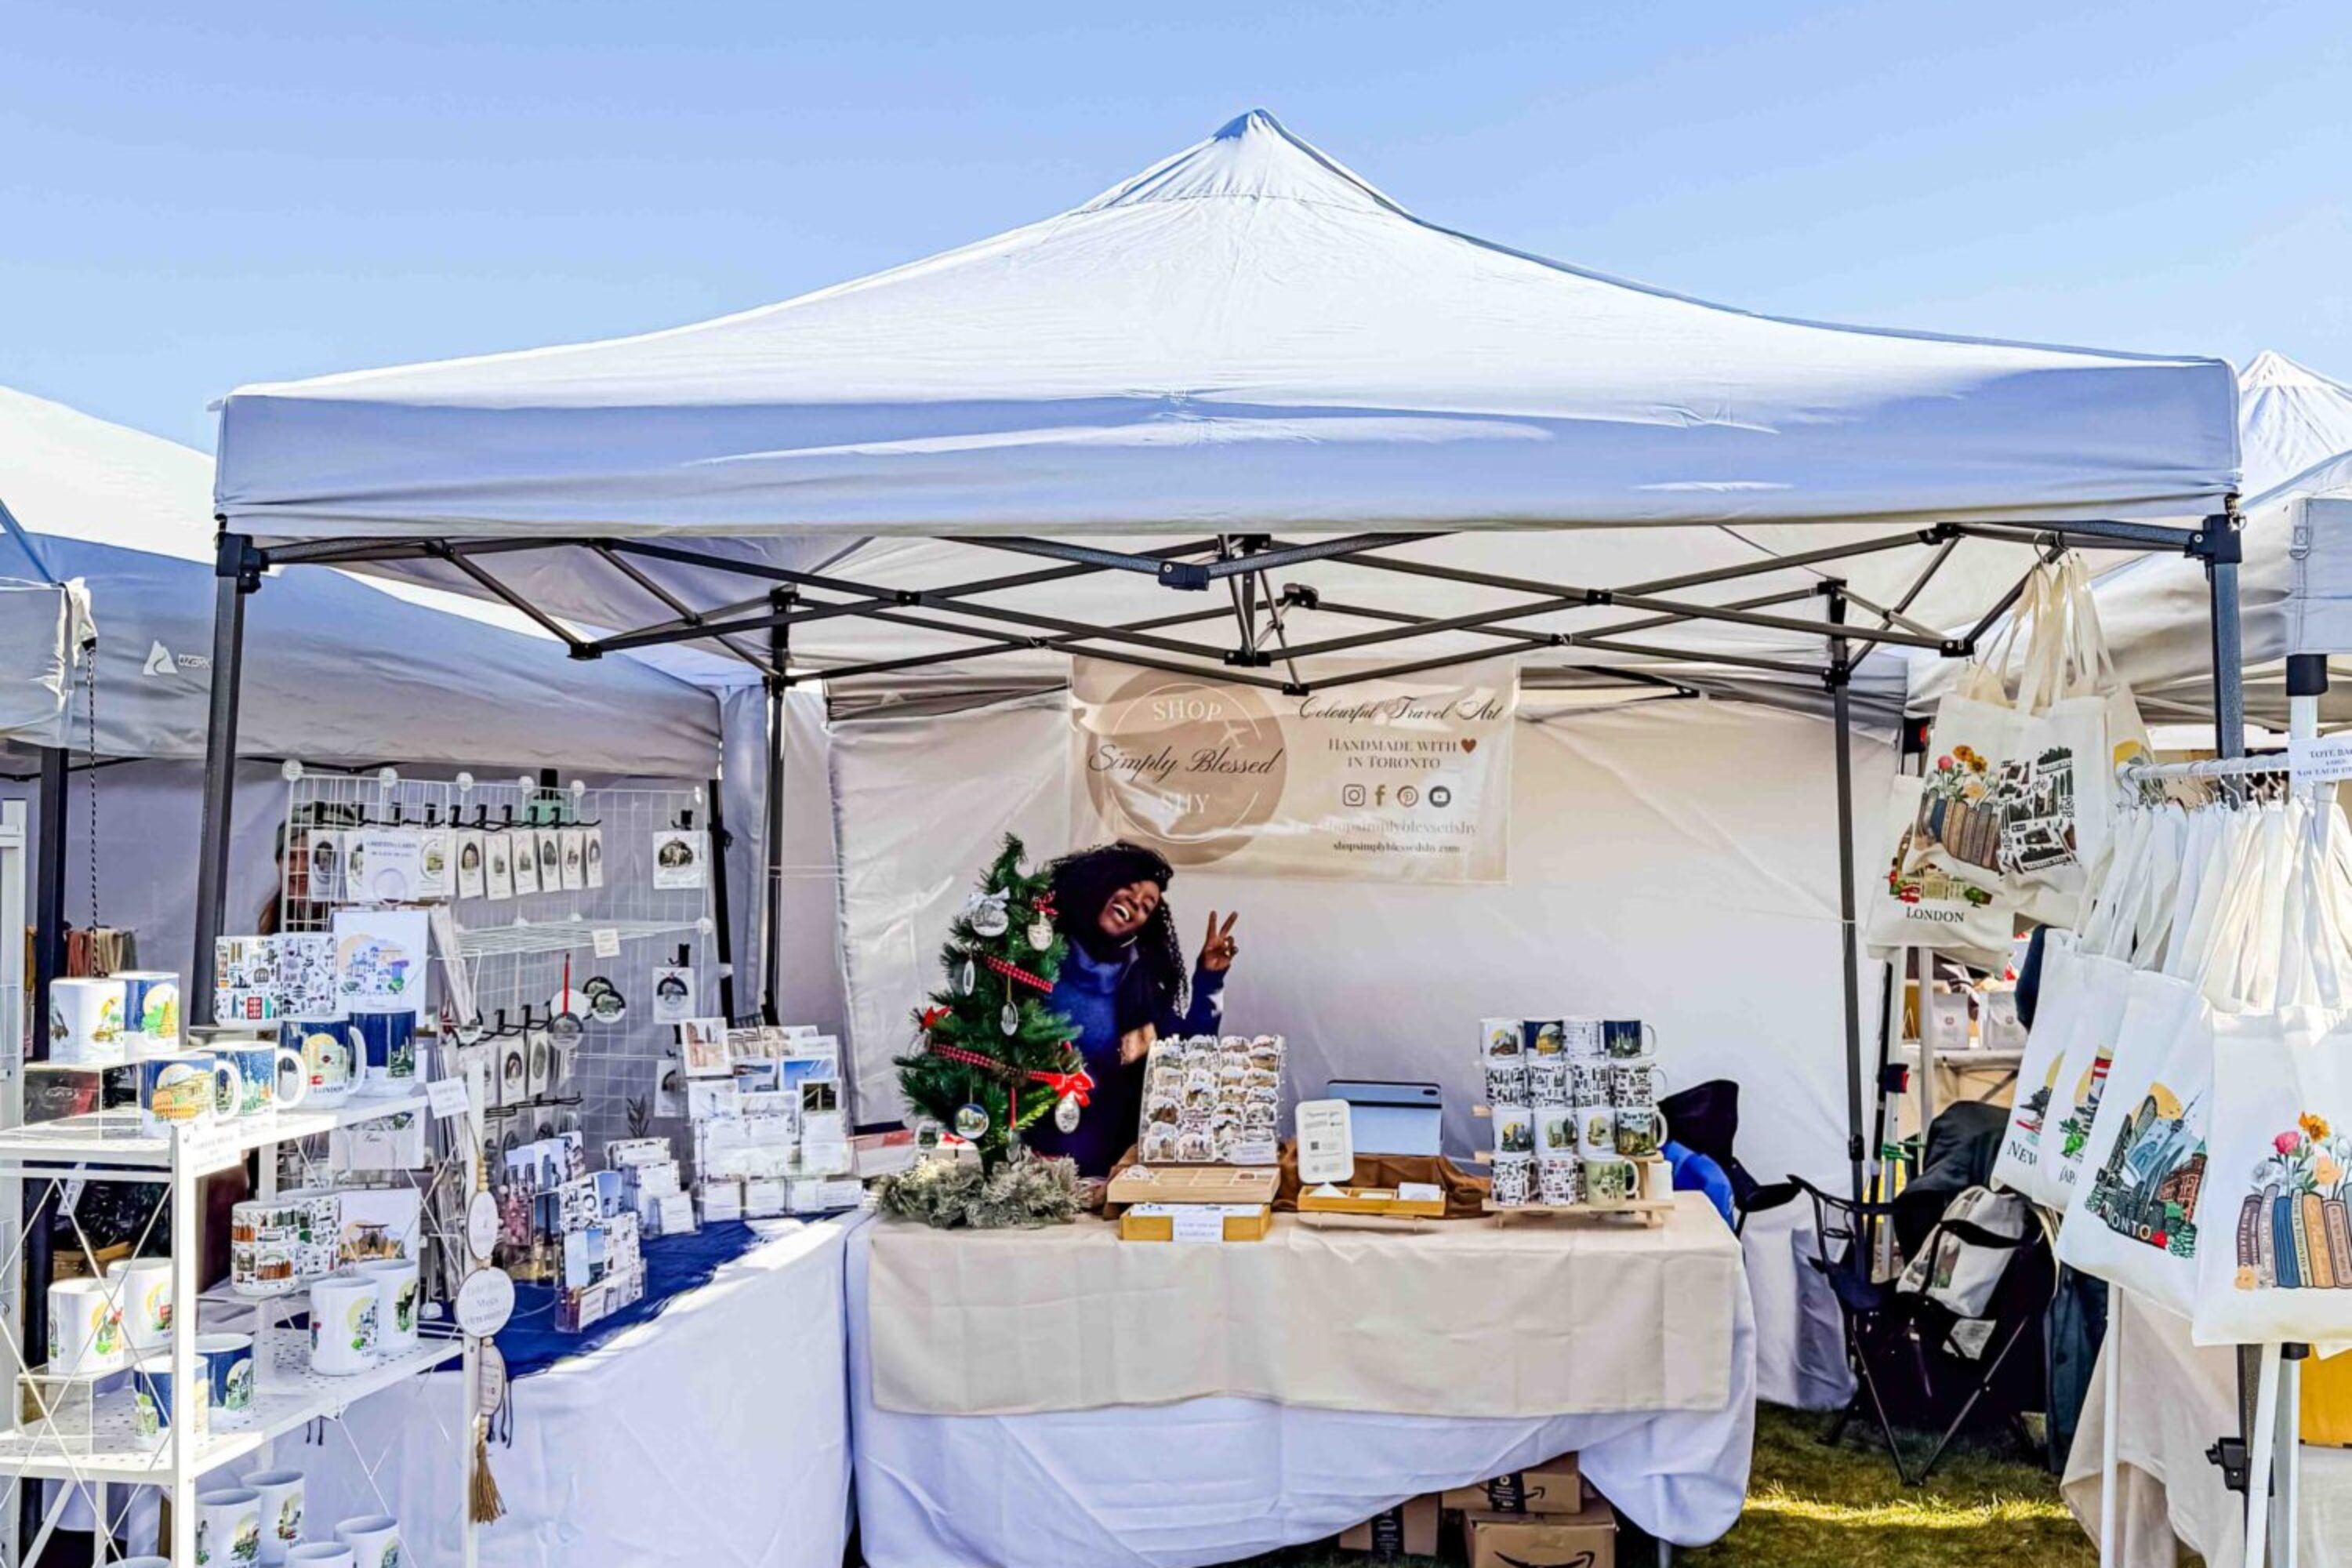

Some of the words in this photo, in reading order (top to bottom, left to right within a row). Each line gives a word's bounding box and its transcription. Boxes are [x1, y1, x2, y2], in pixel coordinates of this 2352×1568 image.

[1152, 699, 1223, 721] SHOP
[1299, 695, 1377, 724] Colourful
[1381, 695, 1453, 720] Travel
[1456, 698, 1504, 720] Art
[1328, 738, 1413, 753] HANDMADE
[1417, 739, 1457, 753] WITH
[1088, 745, 1178, 783] Simply
[1185, 746, 1283, 775] Blessed
[1348, 756, 1363, 768] IN
[1369, 755, 1441, 769] TORONTO
[1160, 793, 1210, 814] SHY
[1906, 906, 1965, 923] LONDON
